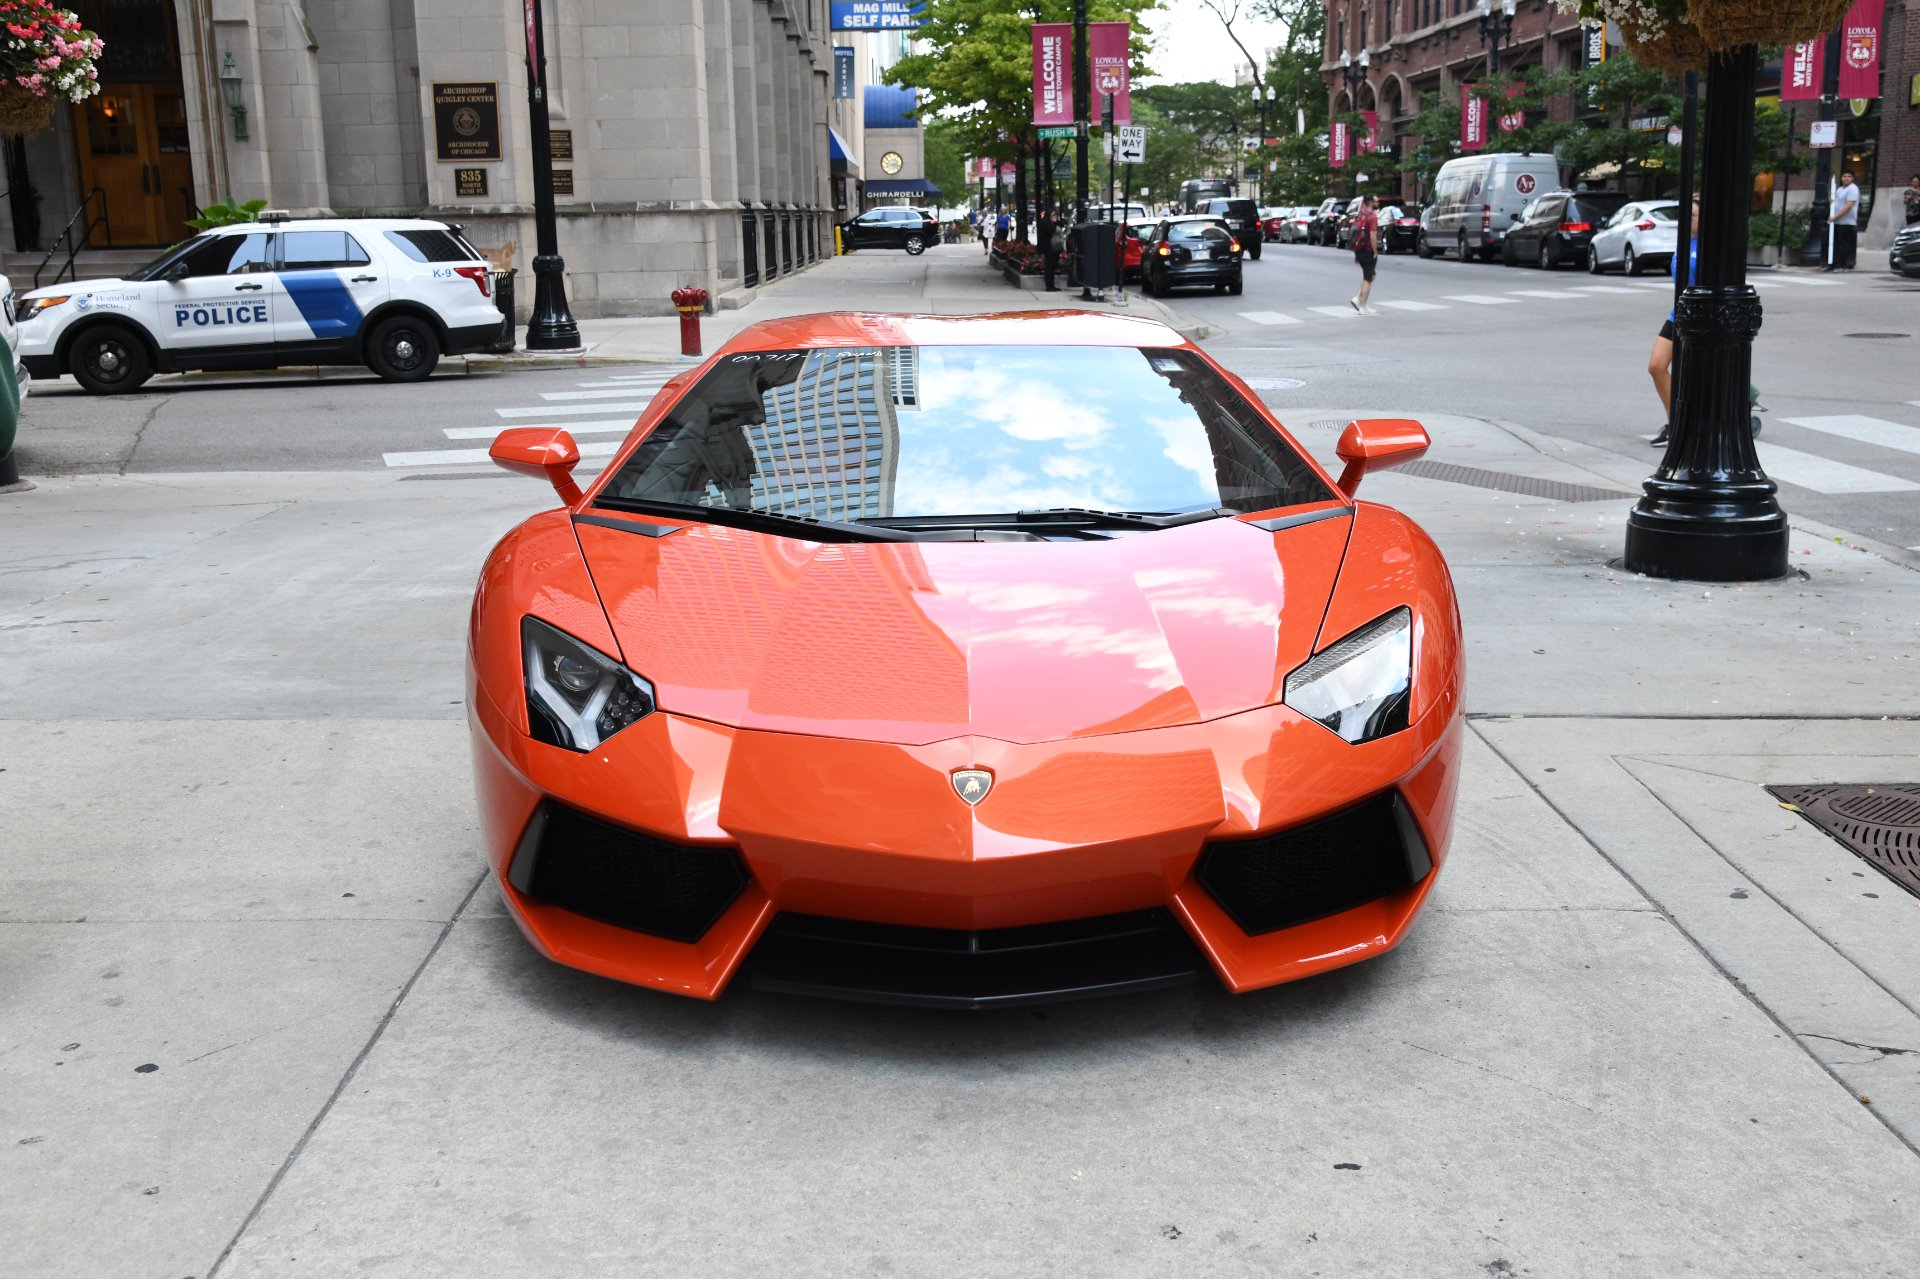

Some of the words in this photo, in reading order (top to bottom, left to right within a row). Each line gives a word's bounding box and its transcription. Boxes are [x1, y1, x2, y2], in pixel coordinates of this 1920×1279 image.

[853, 3, 879, 13] MAG
[843, 15, 878, 27] SELF
[1848, 27, 1876, 35] LOYOLA
[1043, 36, 1056, 114] WELCOME
[1805, 64, 1813, 87] WATER
[442, 87, 487, 95] ARCHBISHOP
[436, 96, 466, 104] QUIGLEY
[467, 95, 494, 103] CENTER
[1045, 129, 1065, 137] RUSH
[1122, 128, 1142, 138] ONE
[1121, 139, 1142, 148] WAY
[460, 171, 481, 182] 835
[433, 269, 451, 278] K-9
[96, 293, 141, 302] Homeland
[96, 302, 133, 311] Security
[175, 305, 268, 327] POLICE
